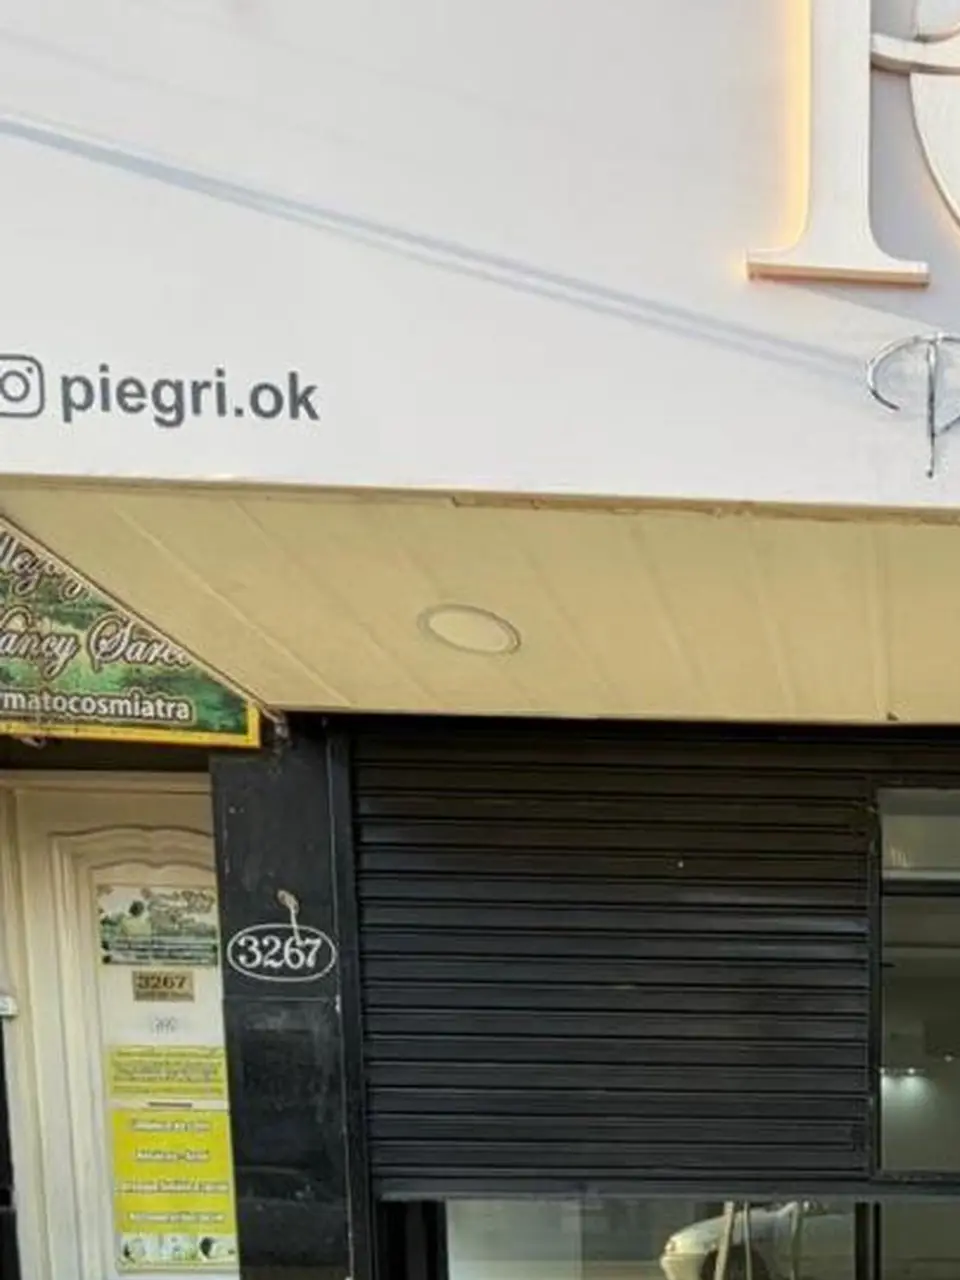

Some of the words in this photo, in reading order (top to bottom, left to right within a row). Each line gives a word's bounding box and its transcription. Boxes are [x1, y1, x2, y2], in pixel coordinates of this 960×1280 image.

[60, 363, 320, 428] piegri.ok
[0, 688, 190, 722] matocosmiatra
[238, 934, 322, 970] 3267
[136, 974, 188, 990] 3267
